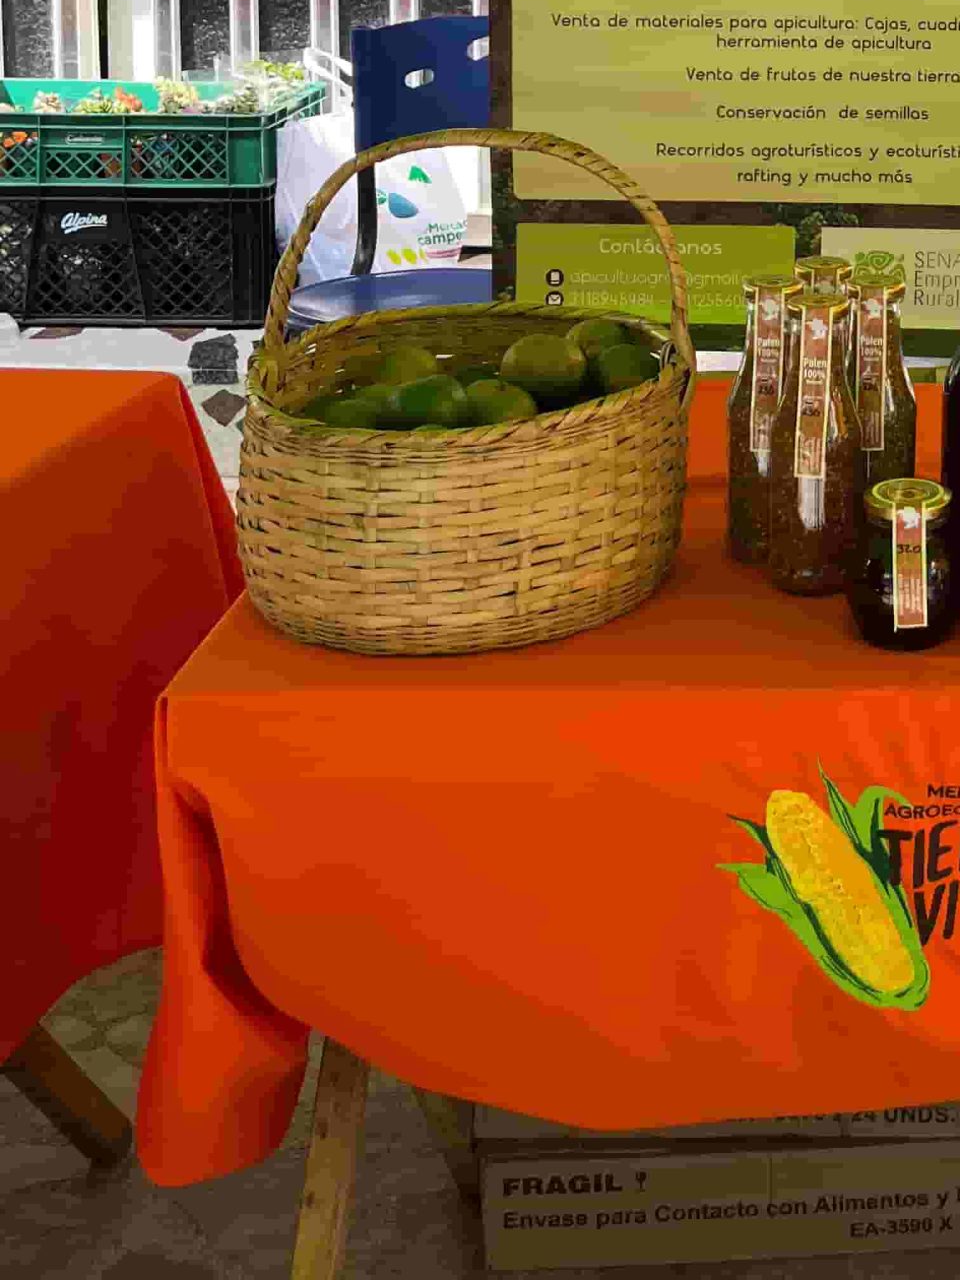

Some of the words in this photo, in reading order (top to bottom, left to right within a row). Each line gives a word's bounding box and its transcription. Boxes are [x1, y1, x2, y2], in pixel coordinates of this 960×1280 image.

[551, 13, 600, 28] Venta
[606, 14, 629, 29] de
[635, 14, 724, 30] materiales
[729, 19, 768, 34] para
[774, 15, 860, 35] apicultura:
[865, 17, 911, 35] Cajas,
[716, 35, 819, 50] herramienta
[825, 35, 845, 50] de
[851, 35, 932, 54] apicultura
[686, 67, 733, 82] Venta
[739, 68, 760, 82] de
[766, 67, 817, 83] frutos
[822, 68, 843, 83] de
[849, 70, 912, 84] nuestra
[917, 69, 960, 84] tierra
[716, 105, 826, 121] Conservación
[839, 106, 860, 121] de
[865, 106, 929, 121] semillas
[656, 143, 745, 158] Recorridos
[751, 143, 862, 163] agroturísticos
[869, 148, 879, 163] y
[737, 169, 792, 189] rafting
[799, 174, 809, 189] y
[815, 170, 873, 186] mucho
[878, 170, 913, 185] más
[61, 212, 108, 229] Alpina
[600, 238, 722, 256] Contácanos
[914, 291, 960, 308] Rural
[803, 357, 827, 368] Polen
[803, 369, 826, 379] 100%
[884, 1108, 956, 1123] UNDS.
[503, 1173, 623, 1197] FRAGIL
[503, 1211, 587, 1229] Envase
[597, 1209, 646, 1229] para
[655, 1200, 758, 1222] Contacto
[767, 1201, 807, 1217] con
[813, 1193, 929, 1213] Alimentos
[936, 1193, 949, 1209] y
